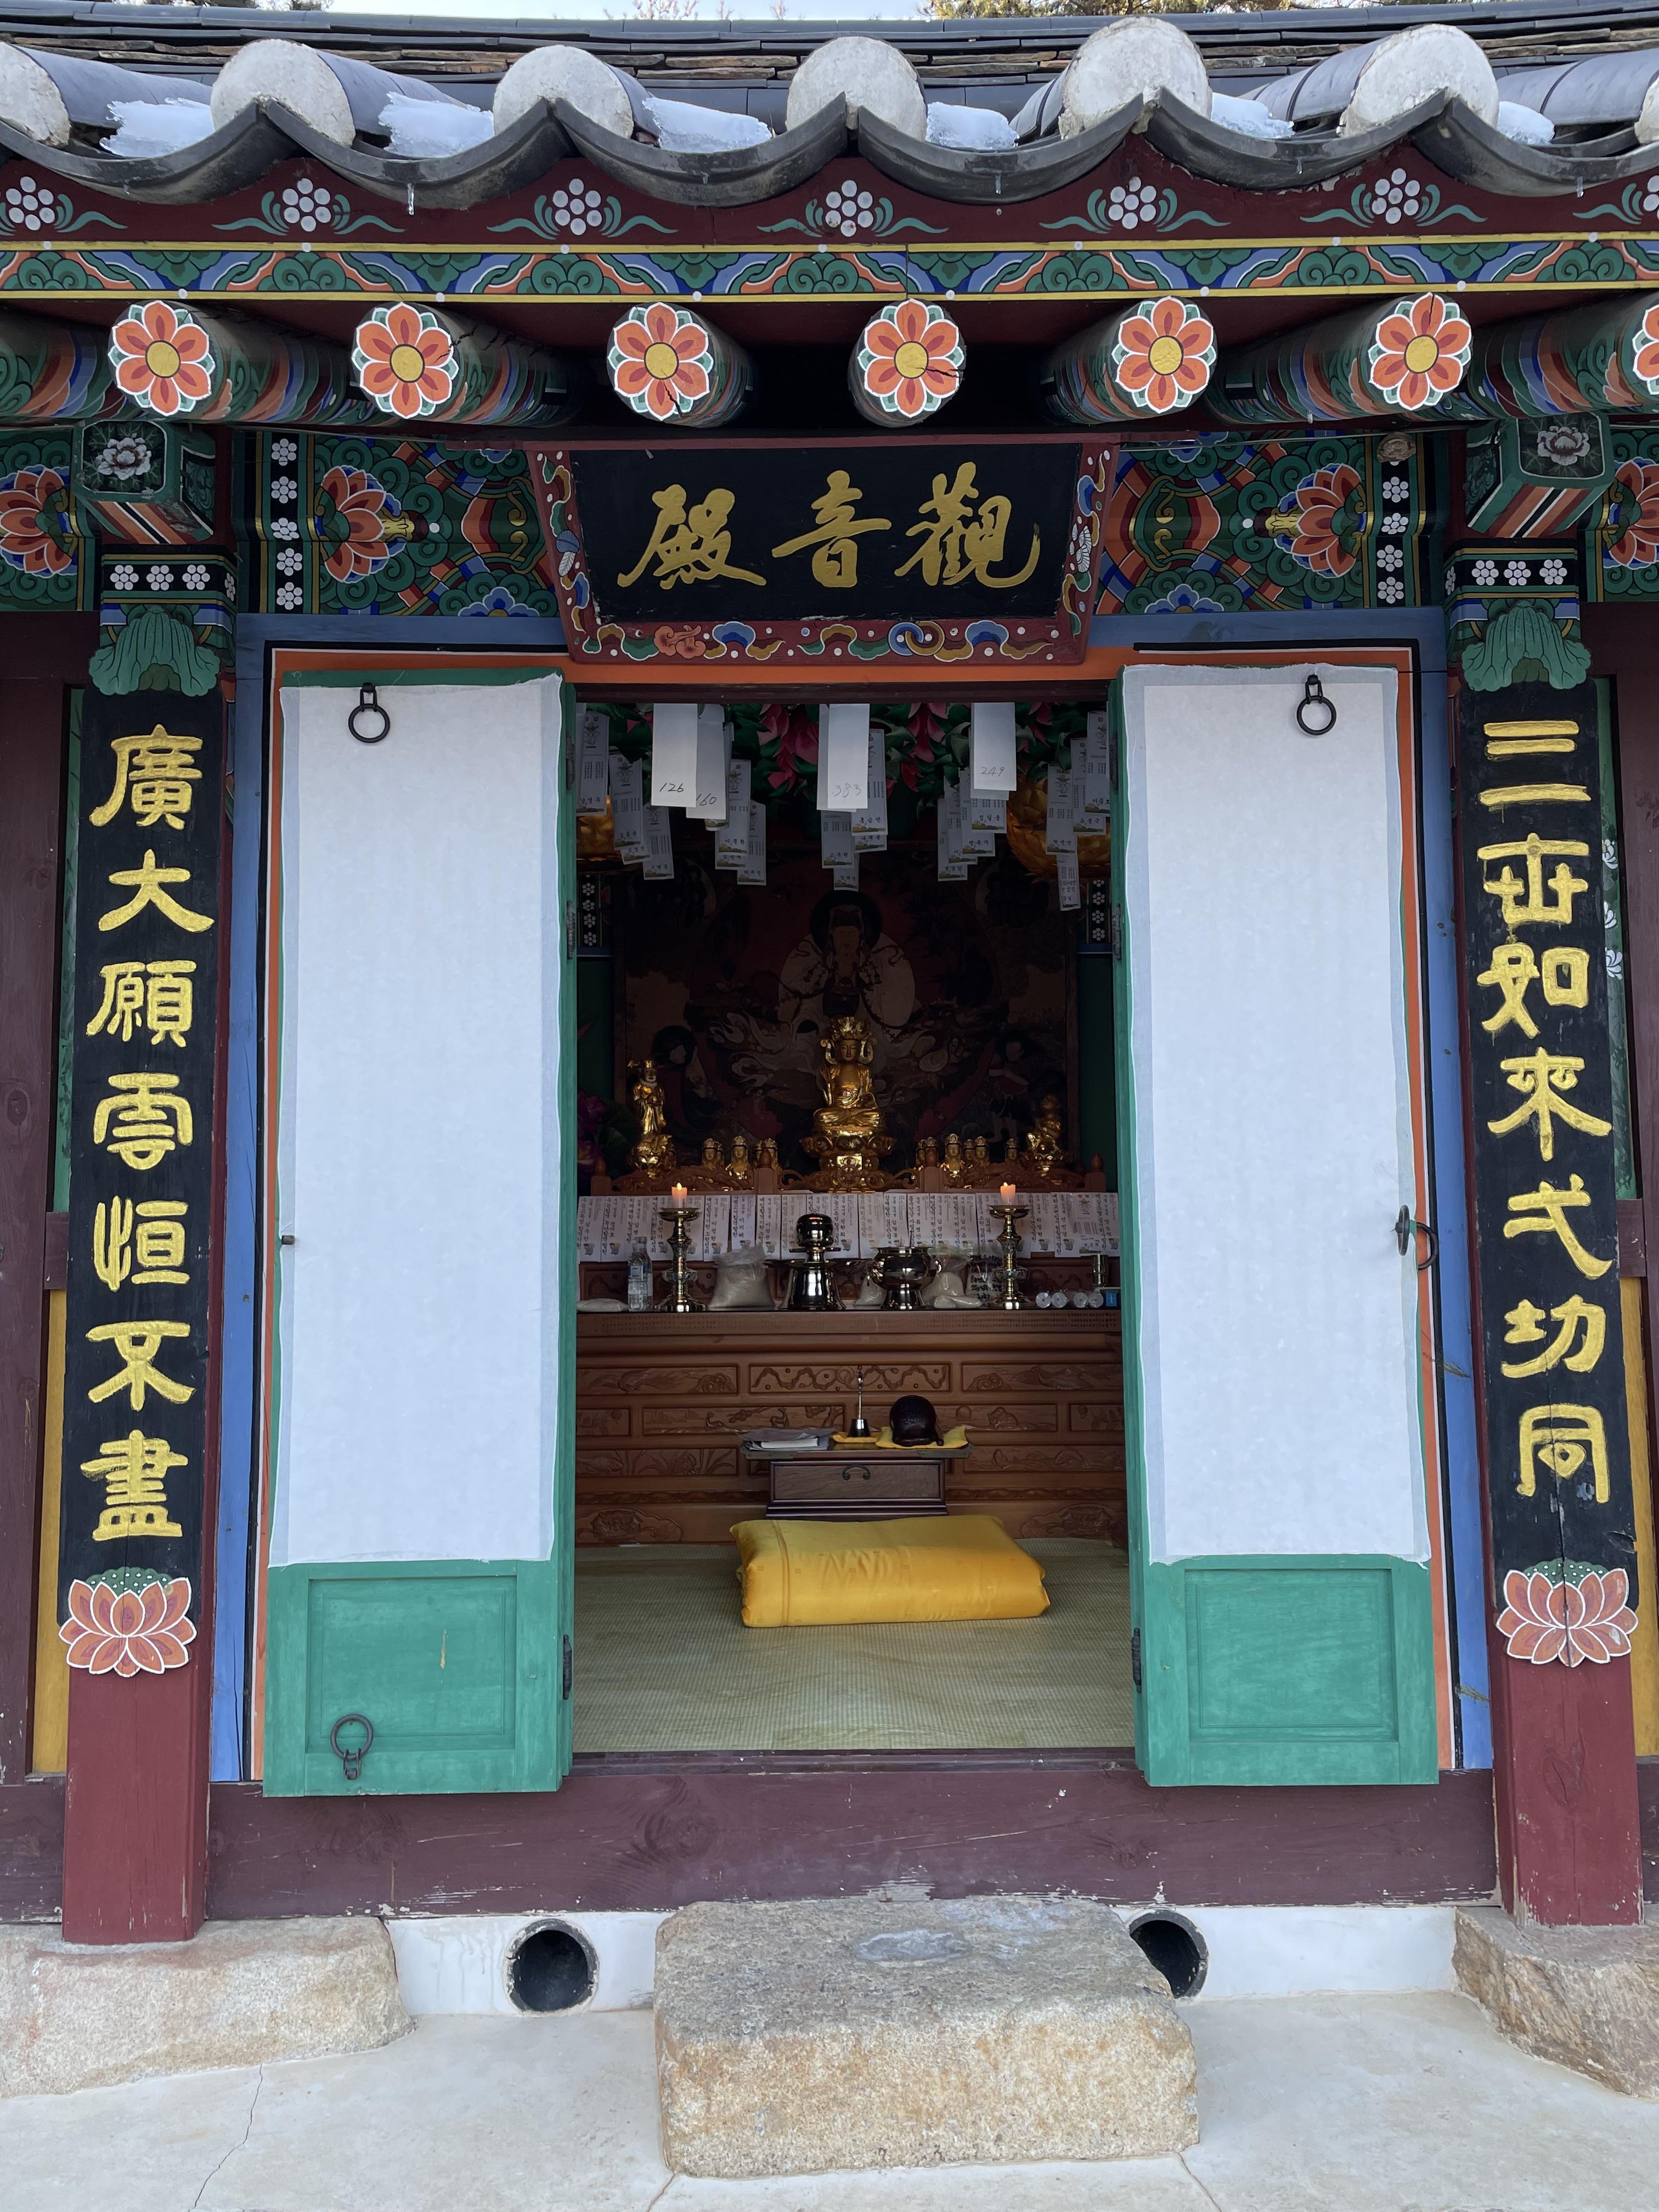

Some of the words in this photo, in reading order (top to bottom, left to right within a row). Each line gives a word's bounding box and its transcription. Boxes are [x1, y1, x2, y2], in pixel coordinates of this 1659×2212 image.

[618, 462, 1039, 587] 觀音殿
[980, 766, 1005, 777] 249
[659, 782, 684, 794] 126
[696, 793, 717, 806] 160
